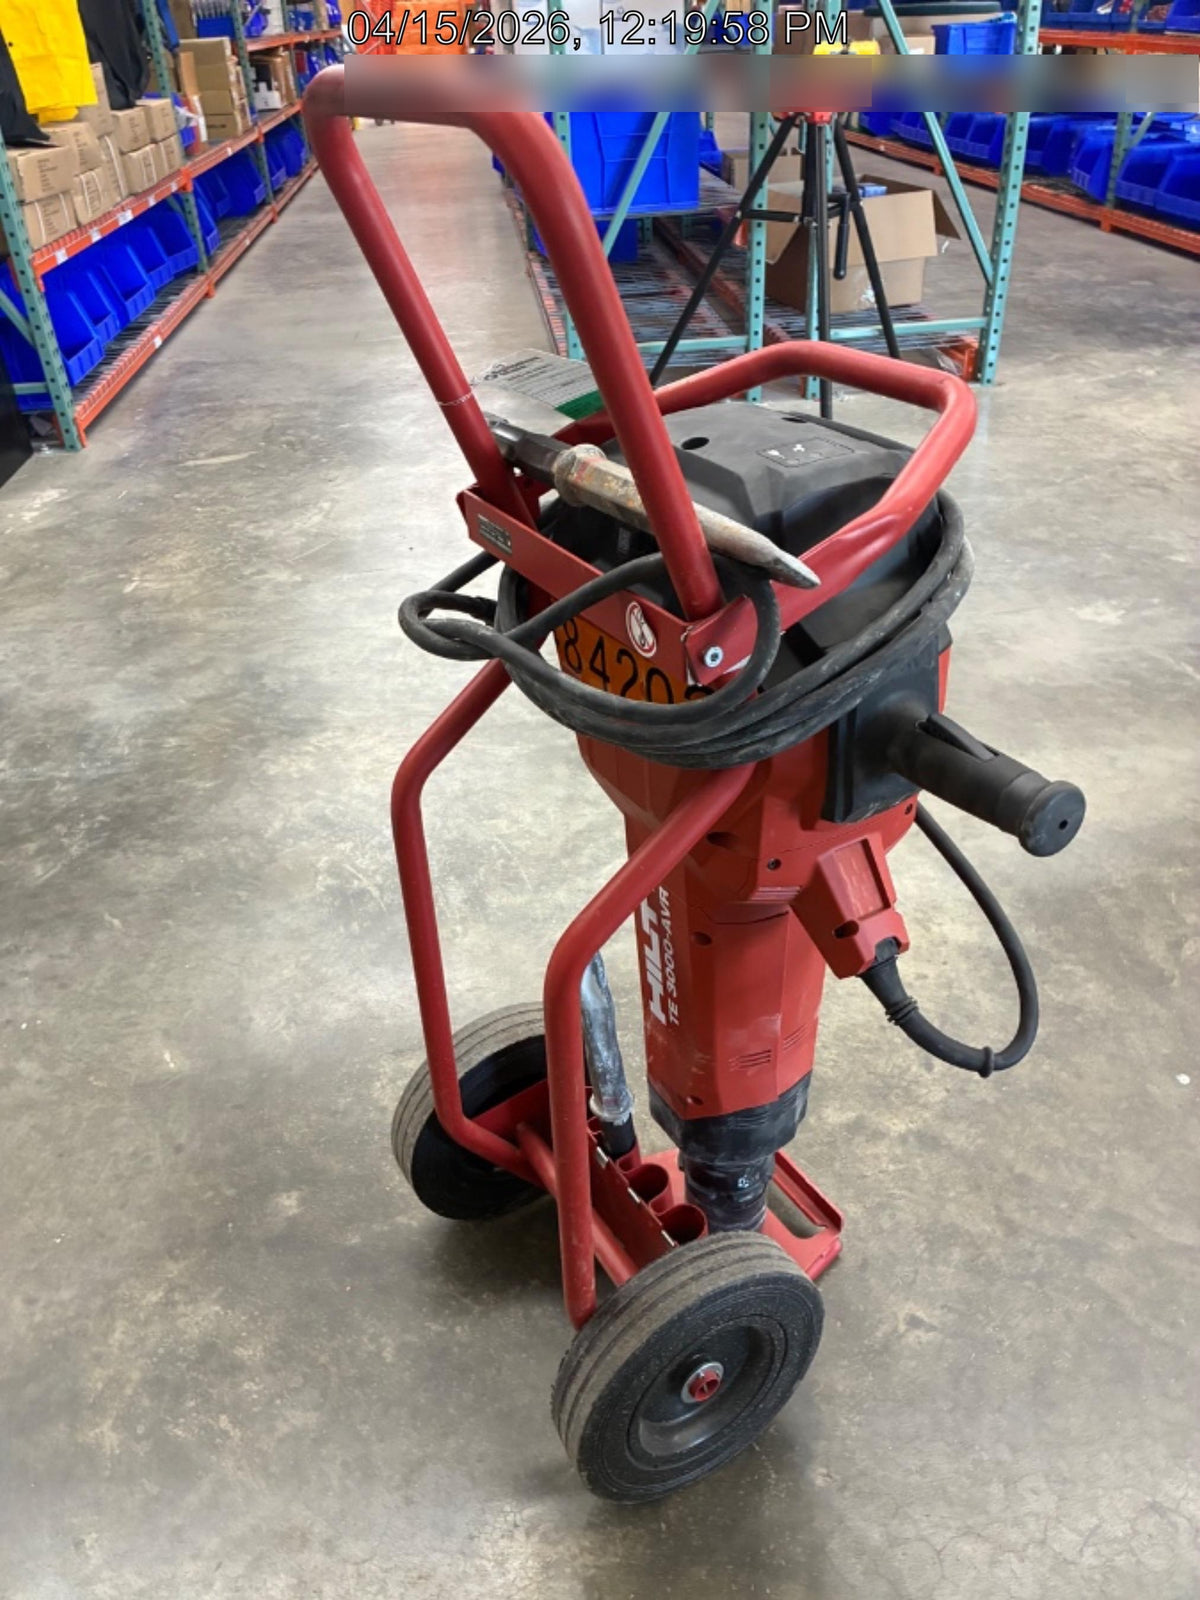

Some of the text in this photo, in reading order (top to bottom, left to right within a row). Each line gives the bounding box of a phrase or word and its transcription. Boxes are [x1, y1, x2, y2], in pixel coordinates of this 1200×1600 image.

[640, 897, 667, 1025] HILT
[658, 885, 679, 1026] TE 3000-AVR
